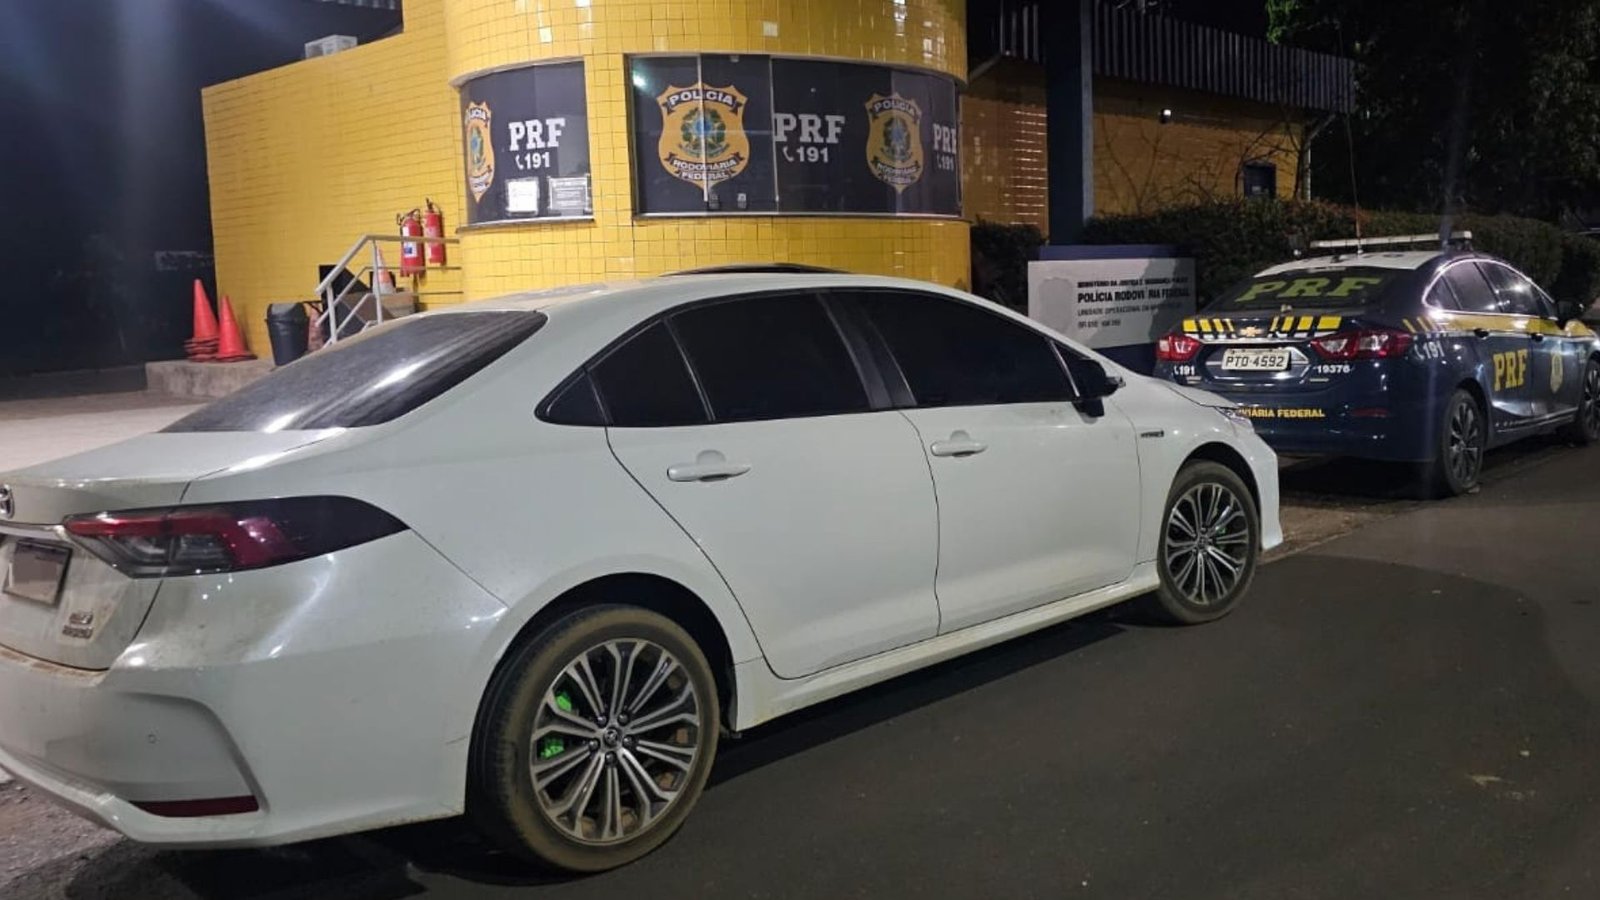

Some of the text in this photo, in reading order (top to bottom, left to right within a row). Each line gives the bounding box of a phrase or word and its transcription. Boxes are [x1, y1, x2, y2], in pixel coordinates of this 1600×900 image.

[669, 89, 734, 106] POLCIA
[508, 117, 566, 152] PRF
[774, 113, 846, 144] PRF
[524, 151, 551, 170] 191
[796, 147, 829, 163] 191
[1077, 290, 1113, 304] POLÍCIA
[1234, 275, 1383, 303] PRF
[1423, 340, 1446, 359] 191
[1178, 364, 1196, 376] 191
[1493, 348, 1529, 392] PRF
[1277, 407, 1327, 419] FEDERAL
